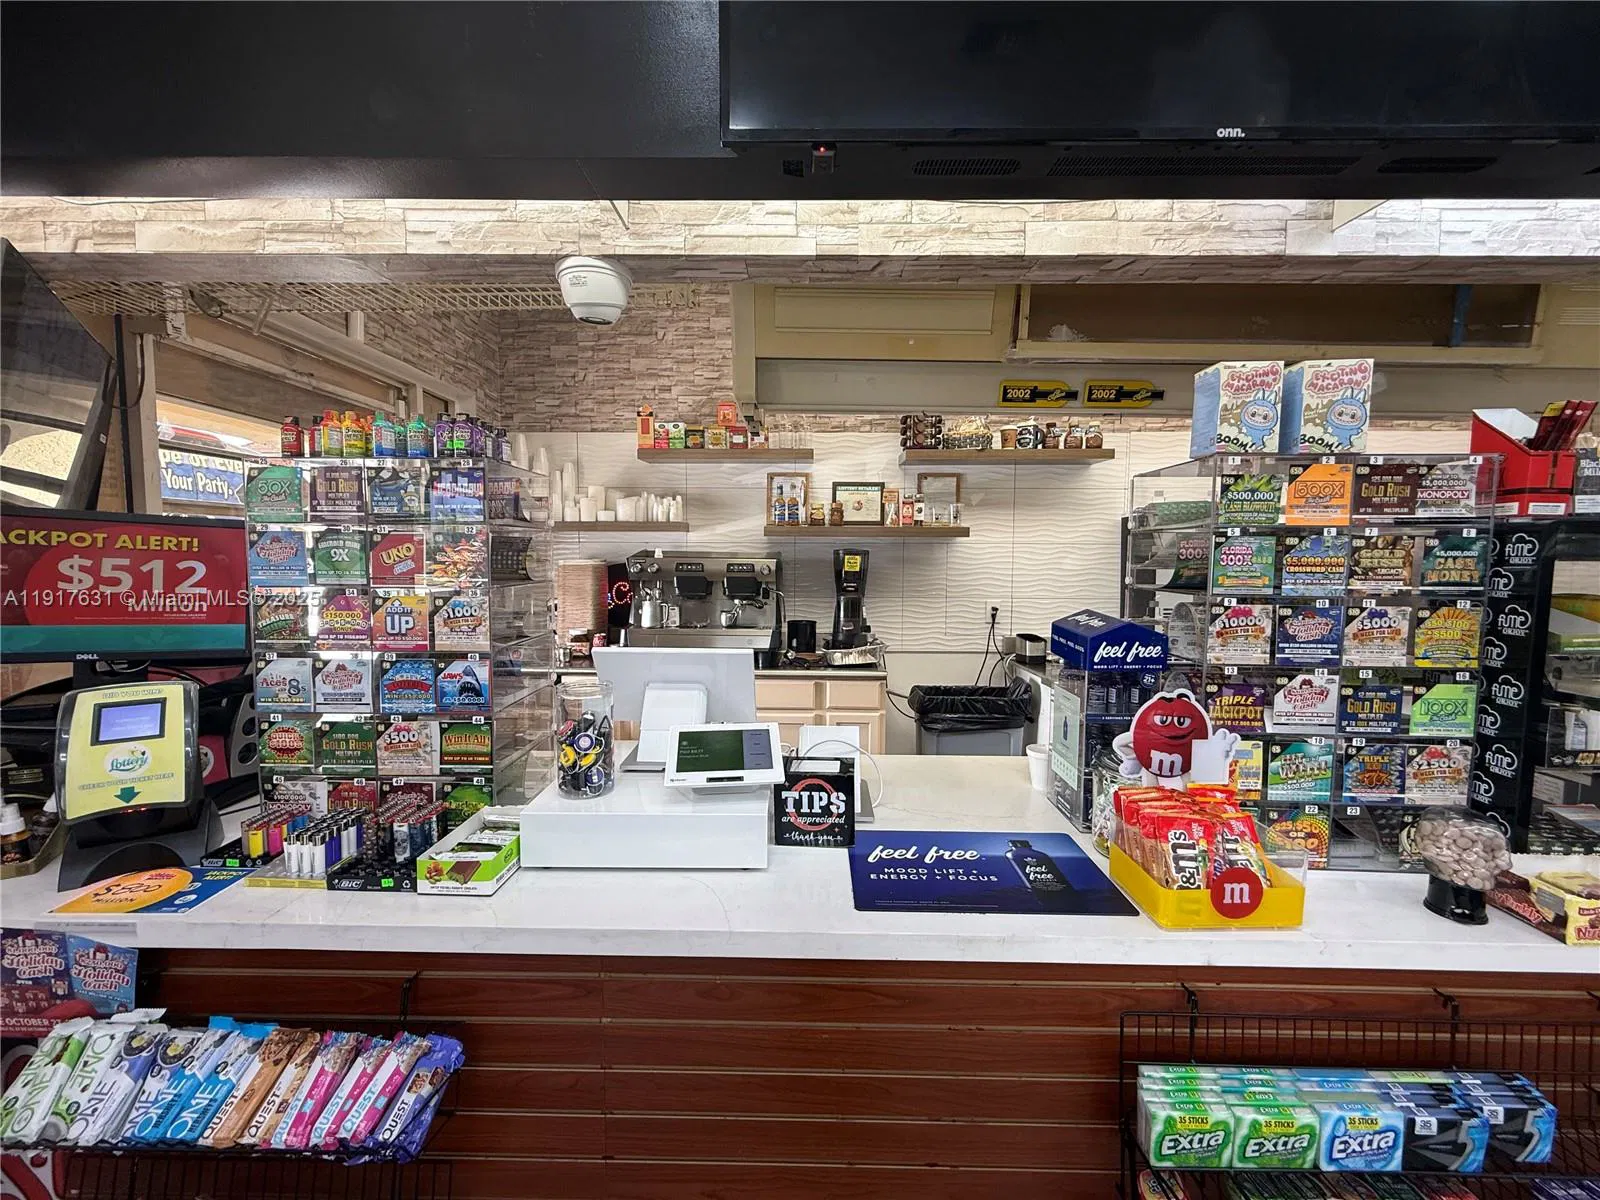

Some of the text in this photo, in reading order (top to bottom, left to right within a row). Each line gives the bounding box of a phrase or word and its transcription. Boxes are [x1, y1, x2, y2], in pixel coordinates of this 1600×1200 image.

[1217, 127, 1246, 138] onn.
[1231, 364, 1280, 382] EXCITING
[1315, 362, 1369, 384] EXCITING
[1224, 379, 1273, 393] MACARON
[1308, 378, 1363, 393] MACARON
[1006, 389, 1031, 398] 2002
[1091, 389, 1117, 398] 2002
[162, 468, 233, 499] Your Party.
[257, 479, 291, 495] 50X
[316, 479, 359, 492] GOLD RUSH
[1296, 482, 1344, 497] 500X
[1361, 482, 1411, 497] GOLD RUSH
[1421, 479, 1466, 487] $5,000,000!
[1227, 491, 1274, 500] $500,000
[1417, 490, 1469, 499] MONOPOLY
[1226, 501, 1242, 512] CASH
[466, 526, 475, 534] 32
[114, 533, 200, 552] ALERT!
[330, 548, 350, 562] 9X
[379, 543, 415, 566] UNO
[1221, 546, 1253, 555] FLORIDA
[1359, 549, 1406, 559] GOLD
[1505, 543, 1533, 557] fume
[1219, 555, 1252, 566] 300X
[1359, 558, 1403, 568] RUSH
[1434, 557, 1477, 570] CASH
[57, 554, 208, 594] $512
[1286, 566, 1345, 574] CROSSWORD CASH
[1424, 568, 1480, 583] MONEY
[386, 615, 415, 635] UP
[1446, 619, 1470, 629] $100
[1433, 629, 1461, 639] $500
[1093, 641, 1128, 663] feel
[440, 672, 464, 680] JAWS
[1143, 675, 1156, 683] 21+
[1491, 682, 1519, 700] fume
[1215, 695, 1257, 706] TRIPLE
[1347, 699, 1397, 714] GOLD RUSH
[1208, 706, 1264, 719] JACKPOT
[1421, 699, 1468, 716] 100X
[384, 730, 419, 744] $500
[444, 733, 462, 747] Win
[462, 733, 472, 745] It
[322, 739, 373, 750] GOLD RUSH
[108, 754, 149, 773] Lottery
[1358, 755, 1390, 763] TRIPLE
[268, 803, 312, 811] MONOPOLY
[328, 798, 374, 810] GOLD RUSH
[781, 790, 847, 814] TIPS
[797, 814, 846, 825] appreciated
[790, 831, 834, 844] thank you
[867, 844, 919, 863] feel
[884, 867, 928, 875] MOOD
[1025, 864, 1048, 874] feel
[870, 873, 927, 881] ENERGY
[1028, 871, 1054, 881] free
[339, 879, 364, 889] BIC
[1222, 882, 1251, 904] m
[2, 953, 65, 970] Holiday
[16, 966, 54, 978] Cash
[71, 965, 131, 986] Holiday
[82, 979, 119, 991] Cash
[6, 1018, 50, 1027] OCTOBER
[134, 1077, 186, 1137] ONE
[166, 1083, 220, 1140] ONE
[247, 1086, 283, 1139] QUEST
[341, 1084, 378, 1134] QUEST
[202, 1091, 241, 1140] QUEST
[312, 1090, 347, 1140] QUEST
[380, 1098, 410, 1142] QUEST
[1486, 1109, 1498, 1119] 35
[271, 1096, 303, 1149] QUEST
[1178, 1116, 1209, 1126] 35 STICKS
[1264, 1120, 1295, 1129] 35 STICKS
[1348, 1117, 1379, 1127] 35 STICKS
[1419, 1119, 1433, 1129] 35
[1514, 1108, 1543, 1163] 5
[1161, 1130, 1226, 1156] Extra
[1245, 1133, 1311, 1158] Extra
[1332, 1130, 1395, 1160] Extra
[1448, 1117, 1479, 1172] 5
